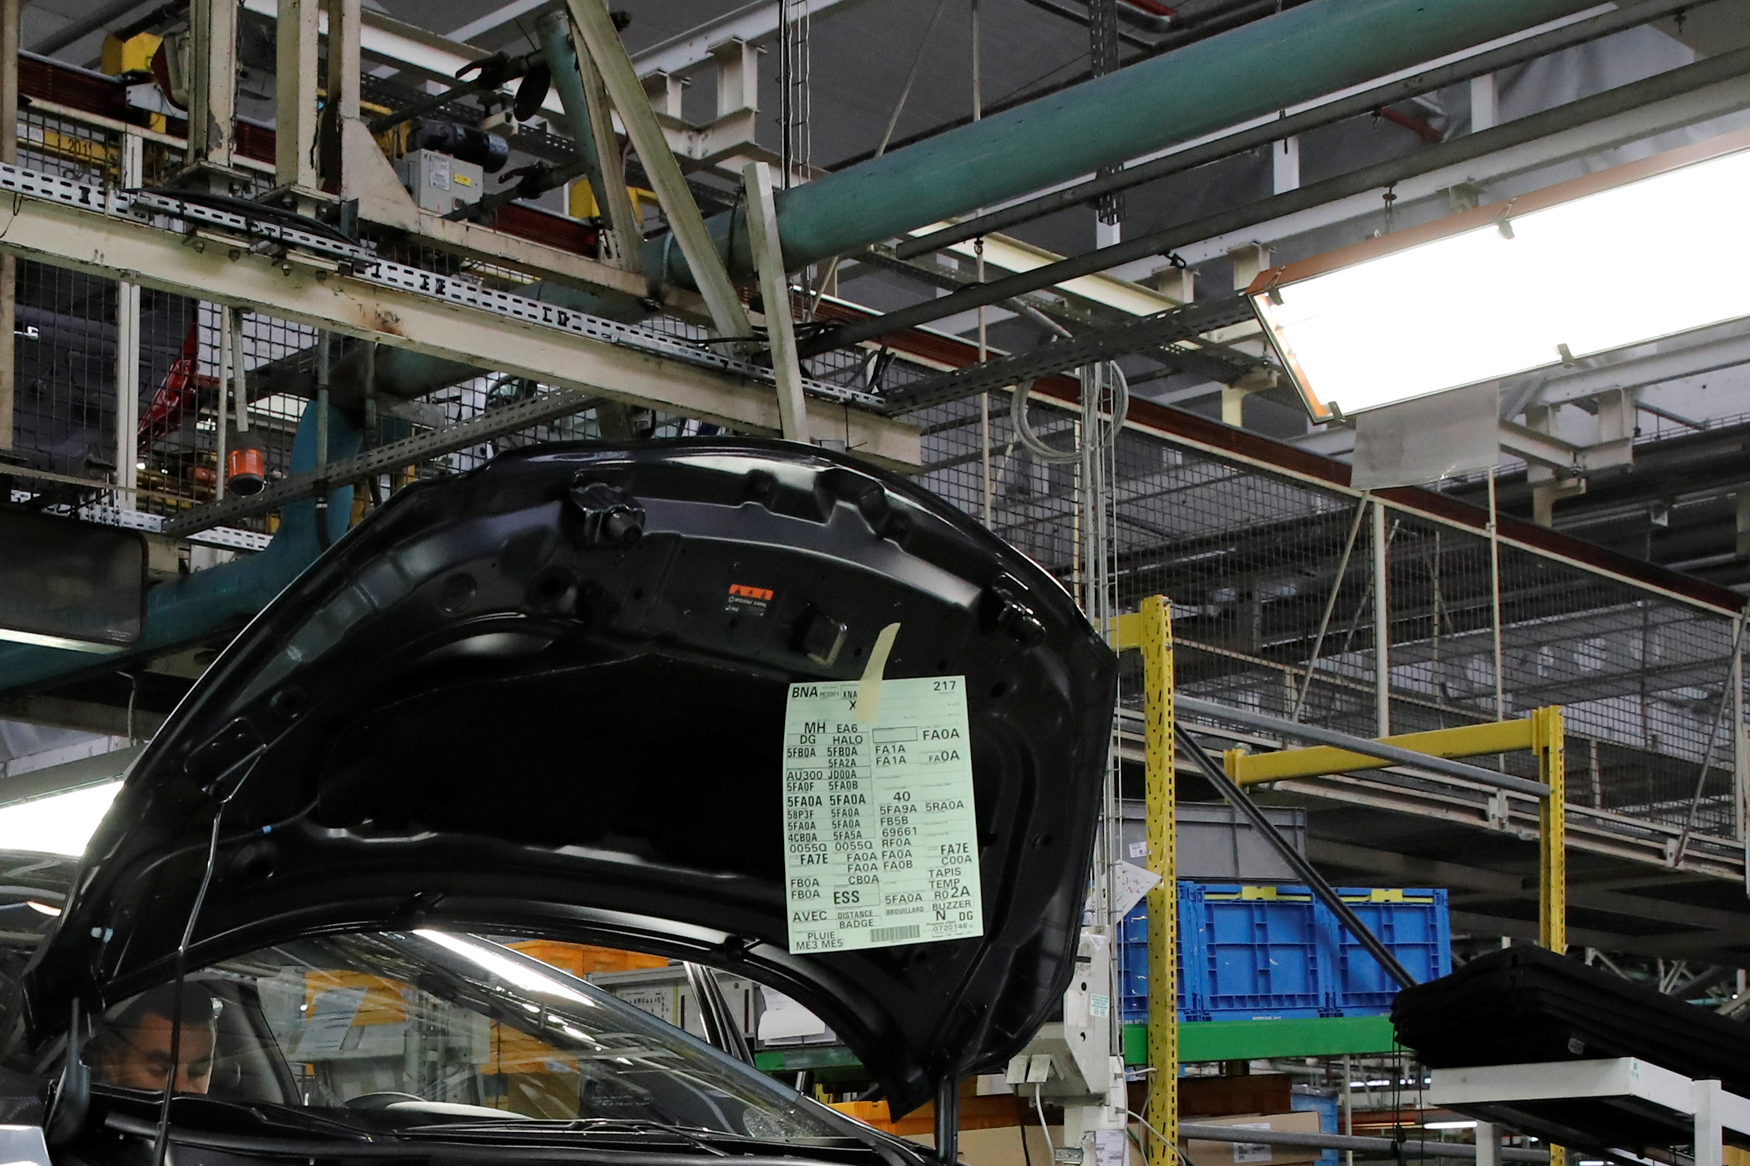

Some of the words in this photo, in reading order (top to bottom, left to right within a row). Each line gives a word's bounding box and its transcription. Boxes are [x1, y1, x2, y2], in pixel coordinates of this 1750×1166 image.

[792, 686, 818, 698] BNA
[934, 681, 956, 691] 217
[805, 722, 826, 734] MH
[837, 723, 858, 733] EA6
[800, 735, 816, 744] DG
[833, 735, 862, 744] HALO
[876, 745, 905, 754] FA1A
[876, 756, 906, 765] FA1A
[787, 771, 823, 780] AU300
[893, 791, 910, 802] 40
[880, 804, 917, 815] 5FA9A
[834, 831, 862, 840] 5FA5A
[882, 827, 916, 837] 69661
[941, 843, 969, 855] FA7E
[800, 854, 828, 865] FA7E
[929, 868, 961, 878] TAPIS
[929, 879, 960, 888] TEMP
[834, 890, 860, 904] ESS
[932, 900, 971, 911] BUZZER
[793, 911, 827, 922] AVEC
[838, 910, 873, 919] DISTANCE
[886, 906, 924, 915] BROUILLARD
[936, 910, 946, 921] N
[959, 911, 973, 921] DG
[840, 919, 874, 929] BADGE
[807, 932, 835, 940] PLUIE
[796, 941, 818, 950] ME3
[822, 940, 843, 948] ME5
